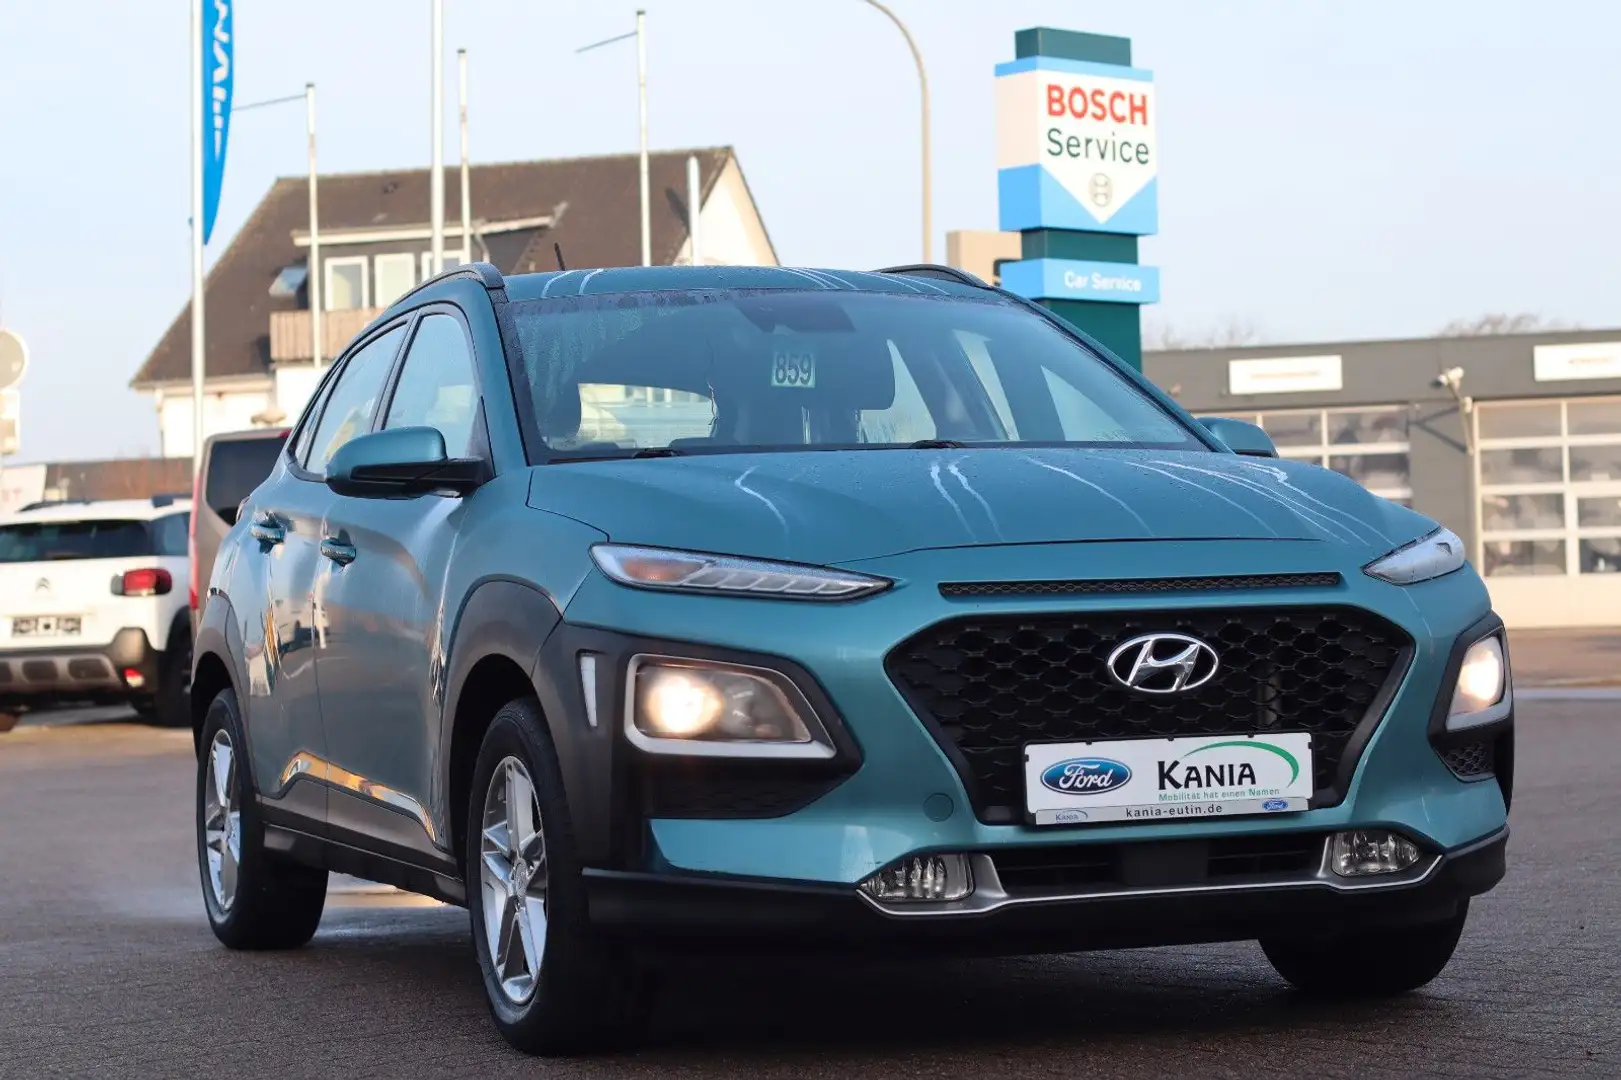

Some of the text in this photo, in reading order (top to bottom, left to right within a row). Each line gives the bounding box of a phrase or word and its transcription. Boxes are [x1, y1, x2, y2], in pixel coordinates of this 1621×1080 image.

[1046, 84, 1148, 126] BOSCH
[1046, 127, 1150, 165] Service
[1064, 270, 1142, 292] Car Service
[774, 353, 812, 385] 859
[1058, 763, 1114, 789] Ford
[1203, 790, 1220, 800] hat
[1221, 789, 1246, 799] einen
[1248, 787, 1280, 797] Namen
[1125, 804, 1223, 818] kania-eutin.de
